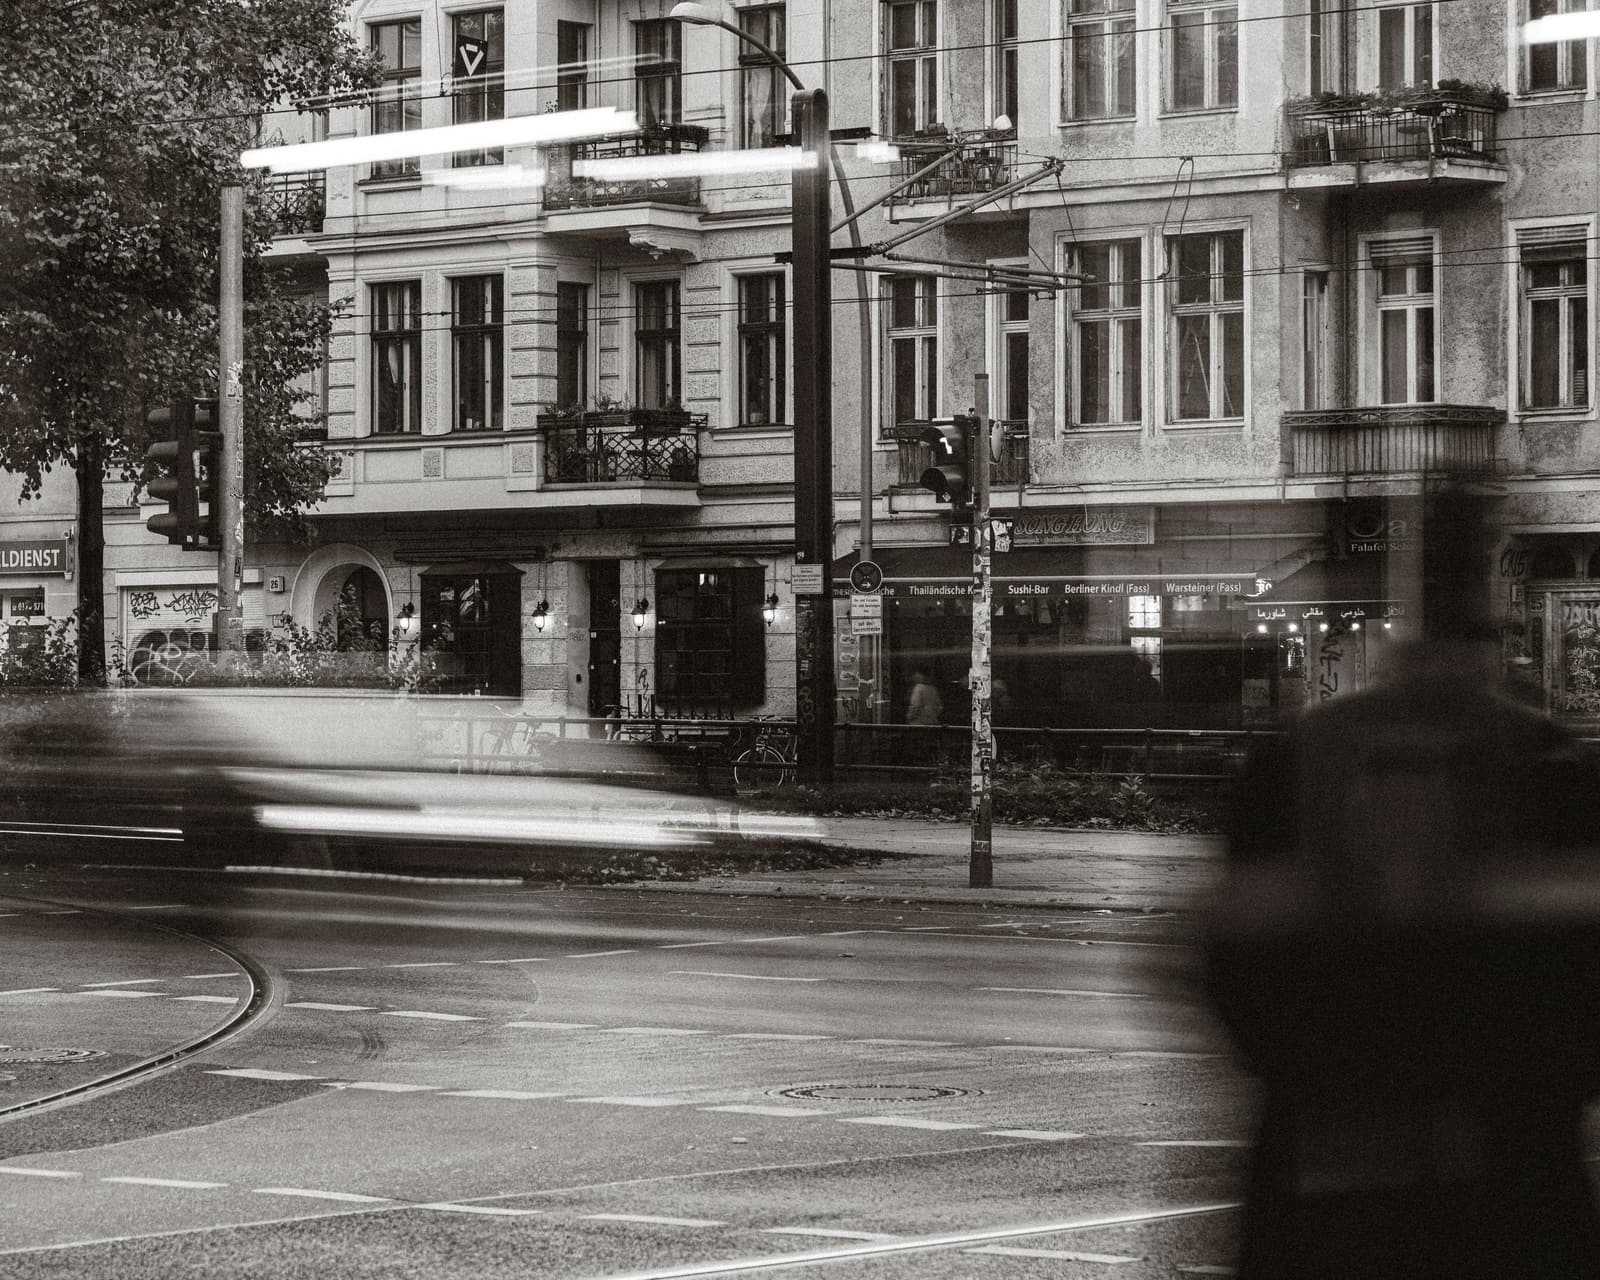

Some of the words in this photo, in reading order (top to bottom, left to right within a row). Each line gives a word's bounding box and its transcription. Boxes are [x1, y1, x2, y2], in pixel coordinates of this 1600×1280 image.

[1013, 513, 1068, 536] SONG
[1066, 512, 1128, 534] HONG
[1351, 542, 1387, 553] Falafel
[270, 579, 279, 590] 26
[909, 584, 966, 596] Thailändische
[1007, 584, 1050, 595] Sushi-Bar
[1064, 583, 1099, 594] Berliner
[1101, 583, 1124, 594] Kindl
[1126, 583, 1150, 595] (Fass)
[1165, 582, 1215, 593] Warsteiner
[1216, 582, 1242, 594] (Fass)
[1257, 607, 1287, 620] شاورما
